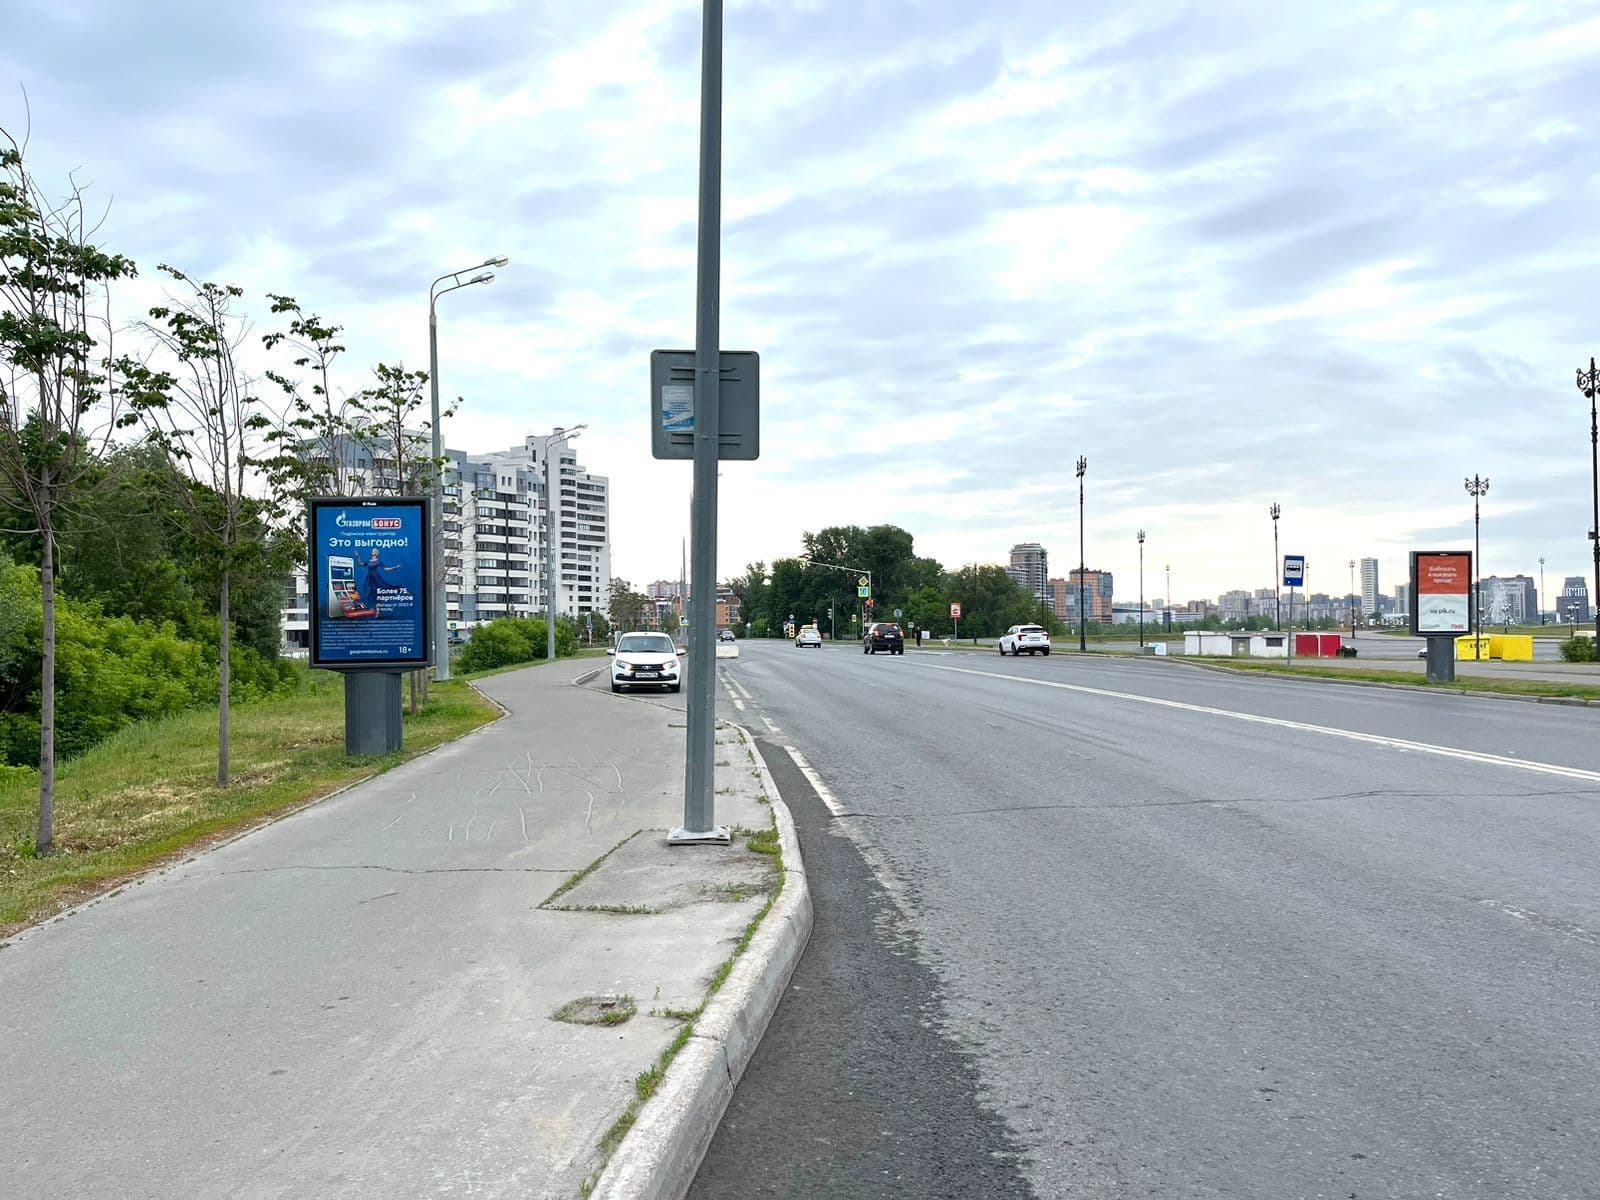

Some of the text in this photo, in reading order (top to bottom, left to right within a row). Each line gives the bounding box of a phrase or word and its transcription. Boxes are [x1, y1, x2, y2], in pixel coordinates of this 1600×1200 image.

[373, 520, 399, 528] БОНУС
[329, 537, 408, 548] Это выгодно!
